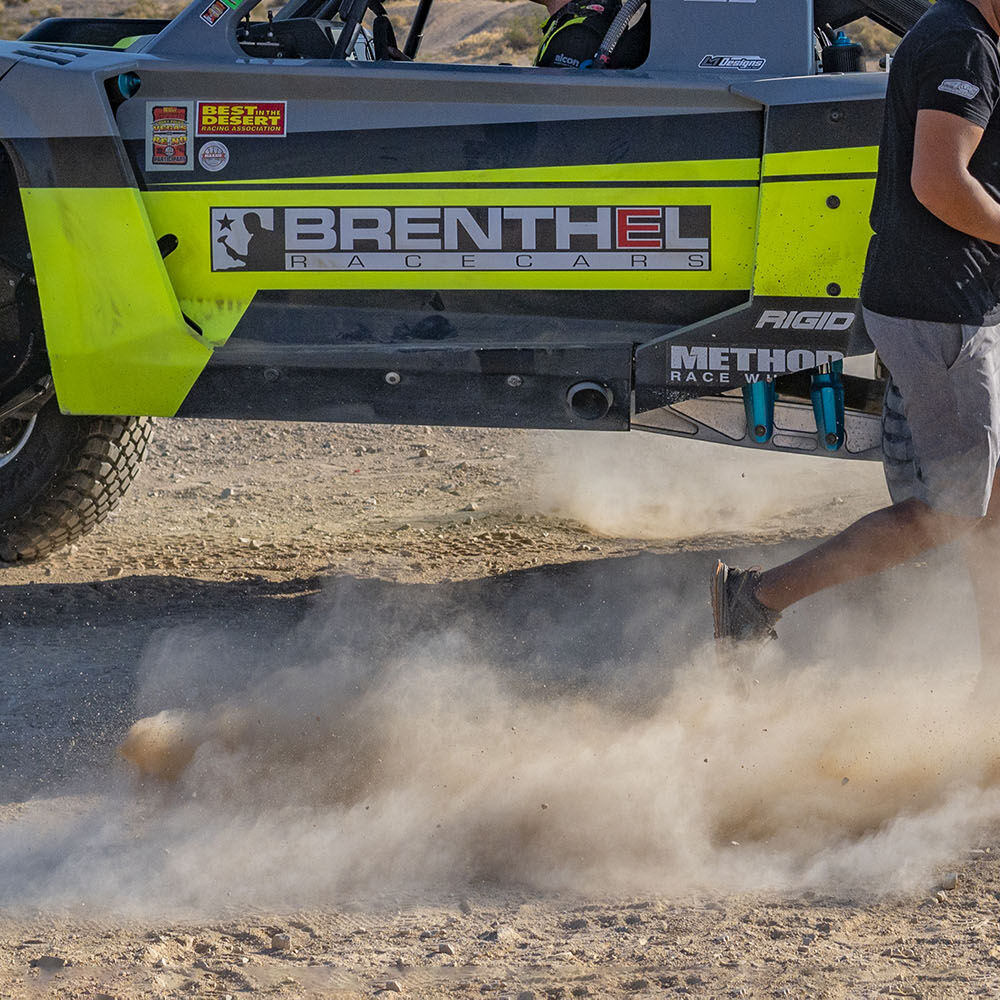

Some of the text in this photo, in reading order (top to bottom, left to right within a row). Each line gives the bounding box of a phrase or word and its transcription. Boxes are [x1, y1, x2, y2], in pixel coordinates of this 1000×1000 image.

[202, 105, 257, 115] BEST
[202, 116, 281, 126] DESERT
[285, 207, 709, 250] BRENTHEL
[292, 253, 705, 269] RACECARS
[755, 310, 856, 331] RIGID
[670, 371, 730, 383] RACE
